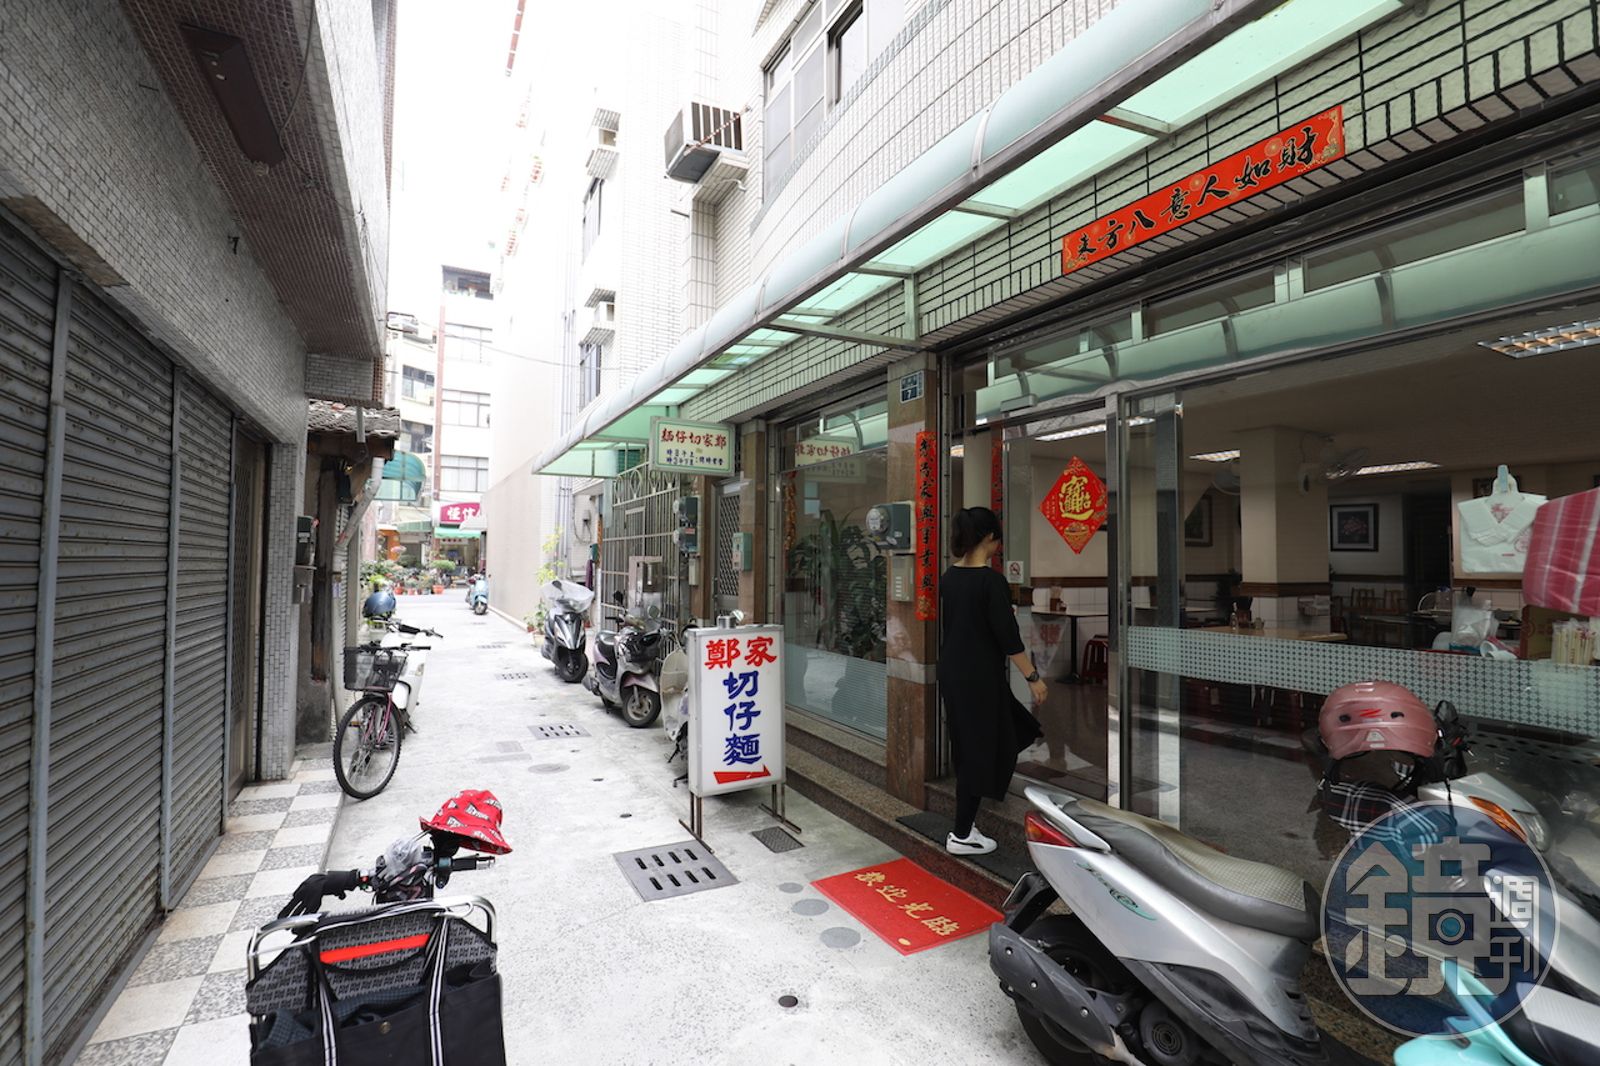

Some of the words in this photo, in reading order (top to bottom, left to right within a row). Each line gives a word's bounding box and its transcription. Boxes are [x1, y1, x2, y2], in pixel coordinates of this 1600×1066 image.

[704, 636, 778, 670] 鄭家
[722, 670, 762, 766] 切仔麵
[853, 871, 961, 937] 歡迎光臨
